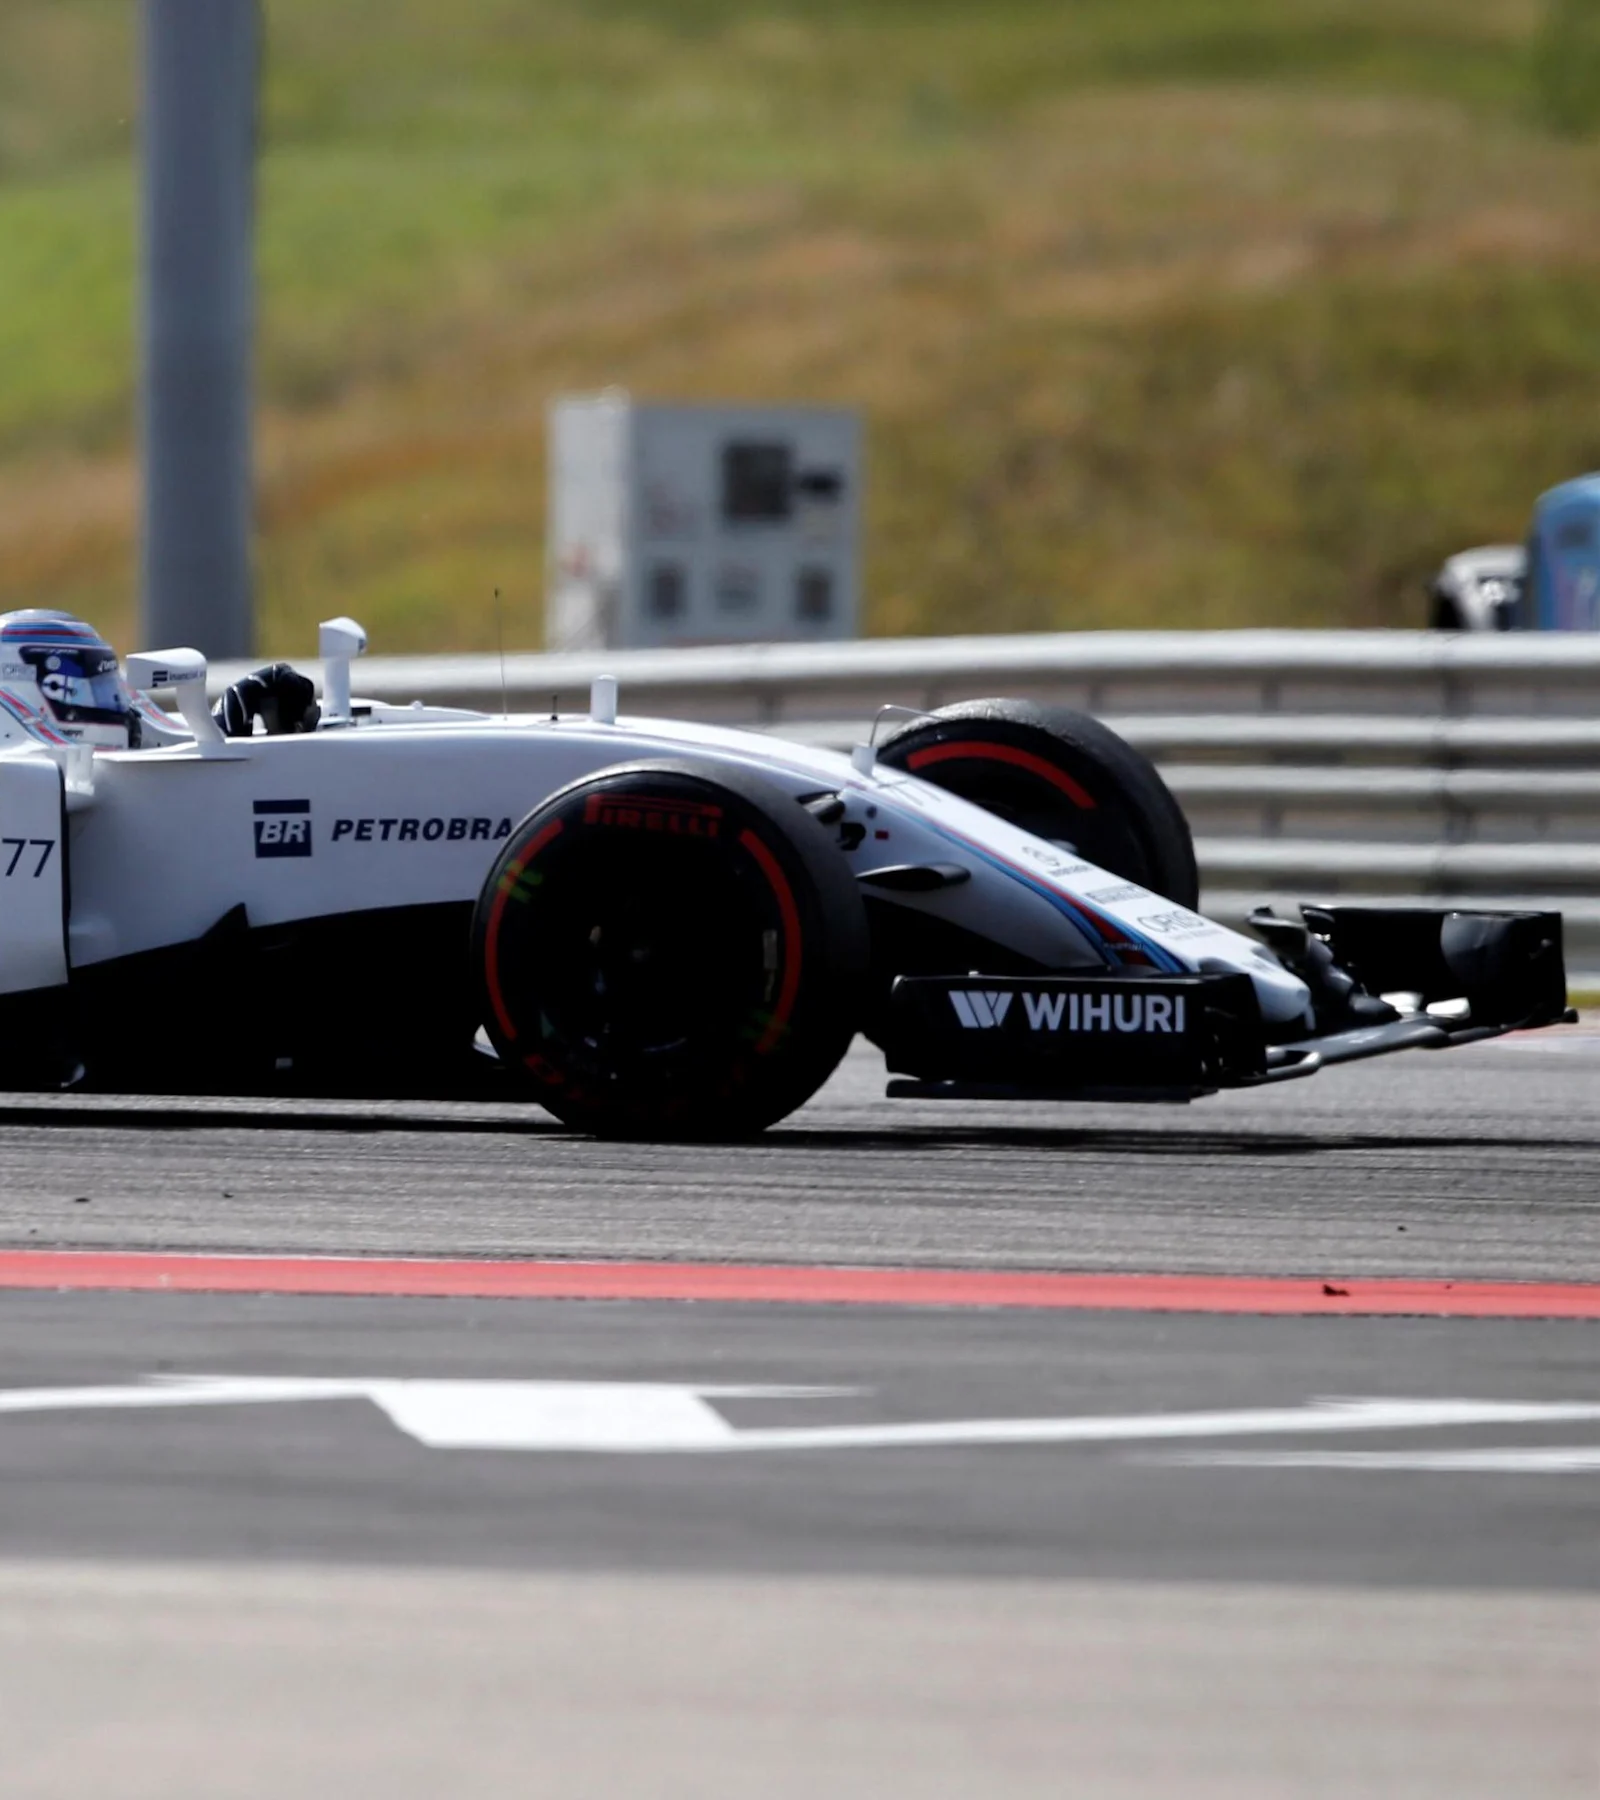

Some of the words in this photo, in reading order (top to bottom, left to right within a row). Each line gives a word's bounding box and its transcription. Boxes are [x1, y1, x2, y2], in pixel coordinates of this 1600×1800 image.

[259, 819, 306, 844] BR
[330, 817, 513, 842] PETROBRA
[583, 793, 725, 838] PIRELLI
[2, 838, 56, 878] 77
[1021, 992, 1186, 1033] WIHURI
